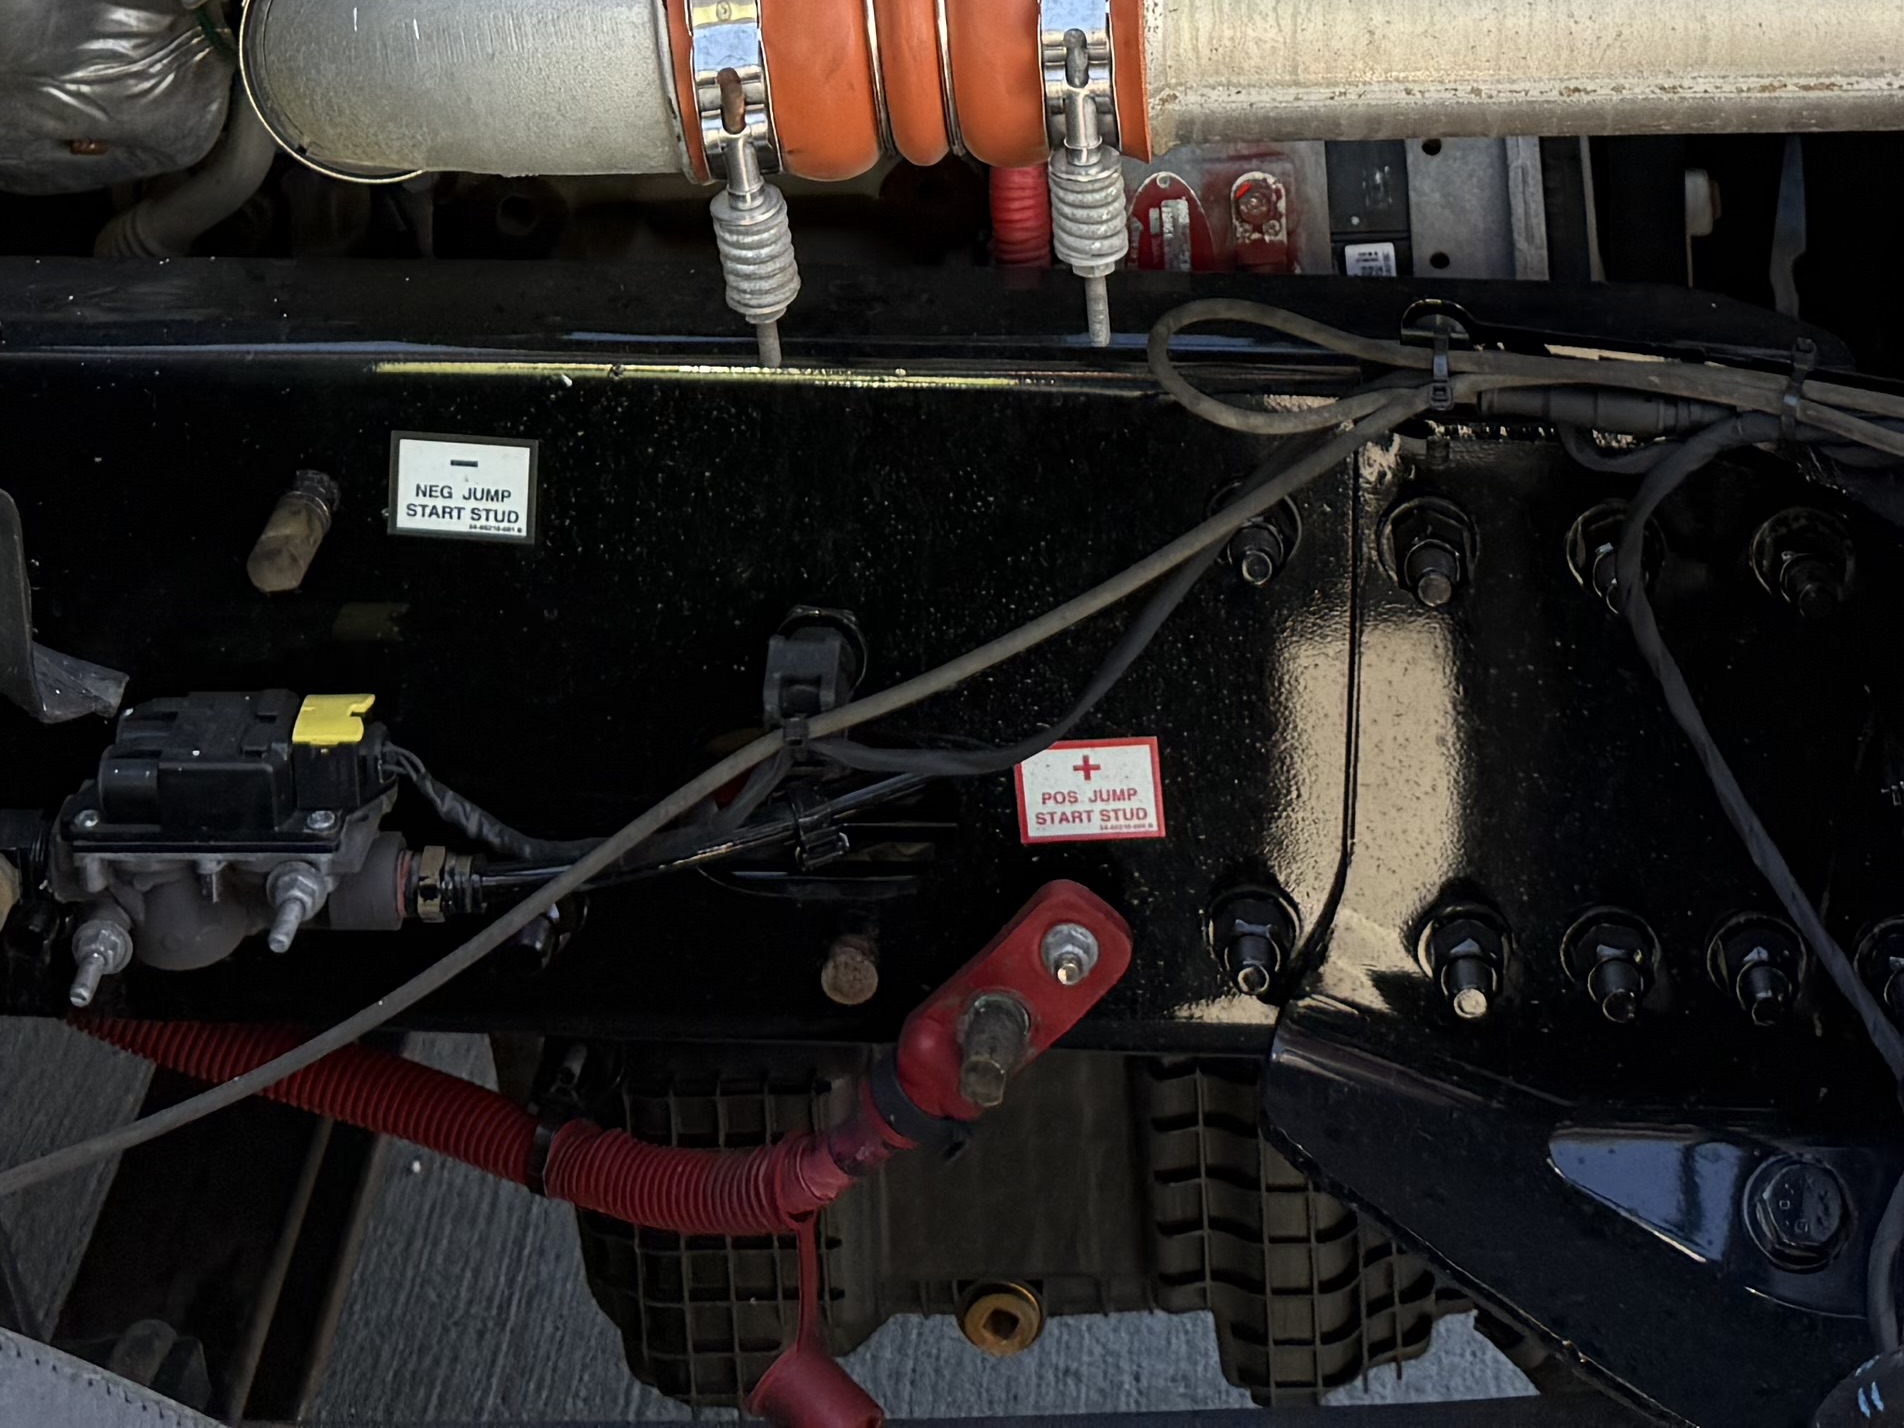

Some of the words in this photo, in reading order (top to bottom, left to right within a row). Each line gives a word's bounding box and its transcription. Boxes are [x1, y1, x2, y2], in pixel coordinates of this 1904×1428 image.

[415, 483, 454, 499] NEG
[462, 487, 512, 503] JUMP
[406, 502, 466, 521] START
[470, 506, 520, 524] STUD
[1041, 790, 1080, 805] POS
[1088, 787, 1139, 804] JUMP
[1035, 810, 1095, 826] START
[1099, 807, 1147, 823] STUD
